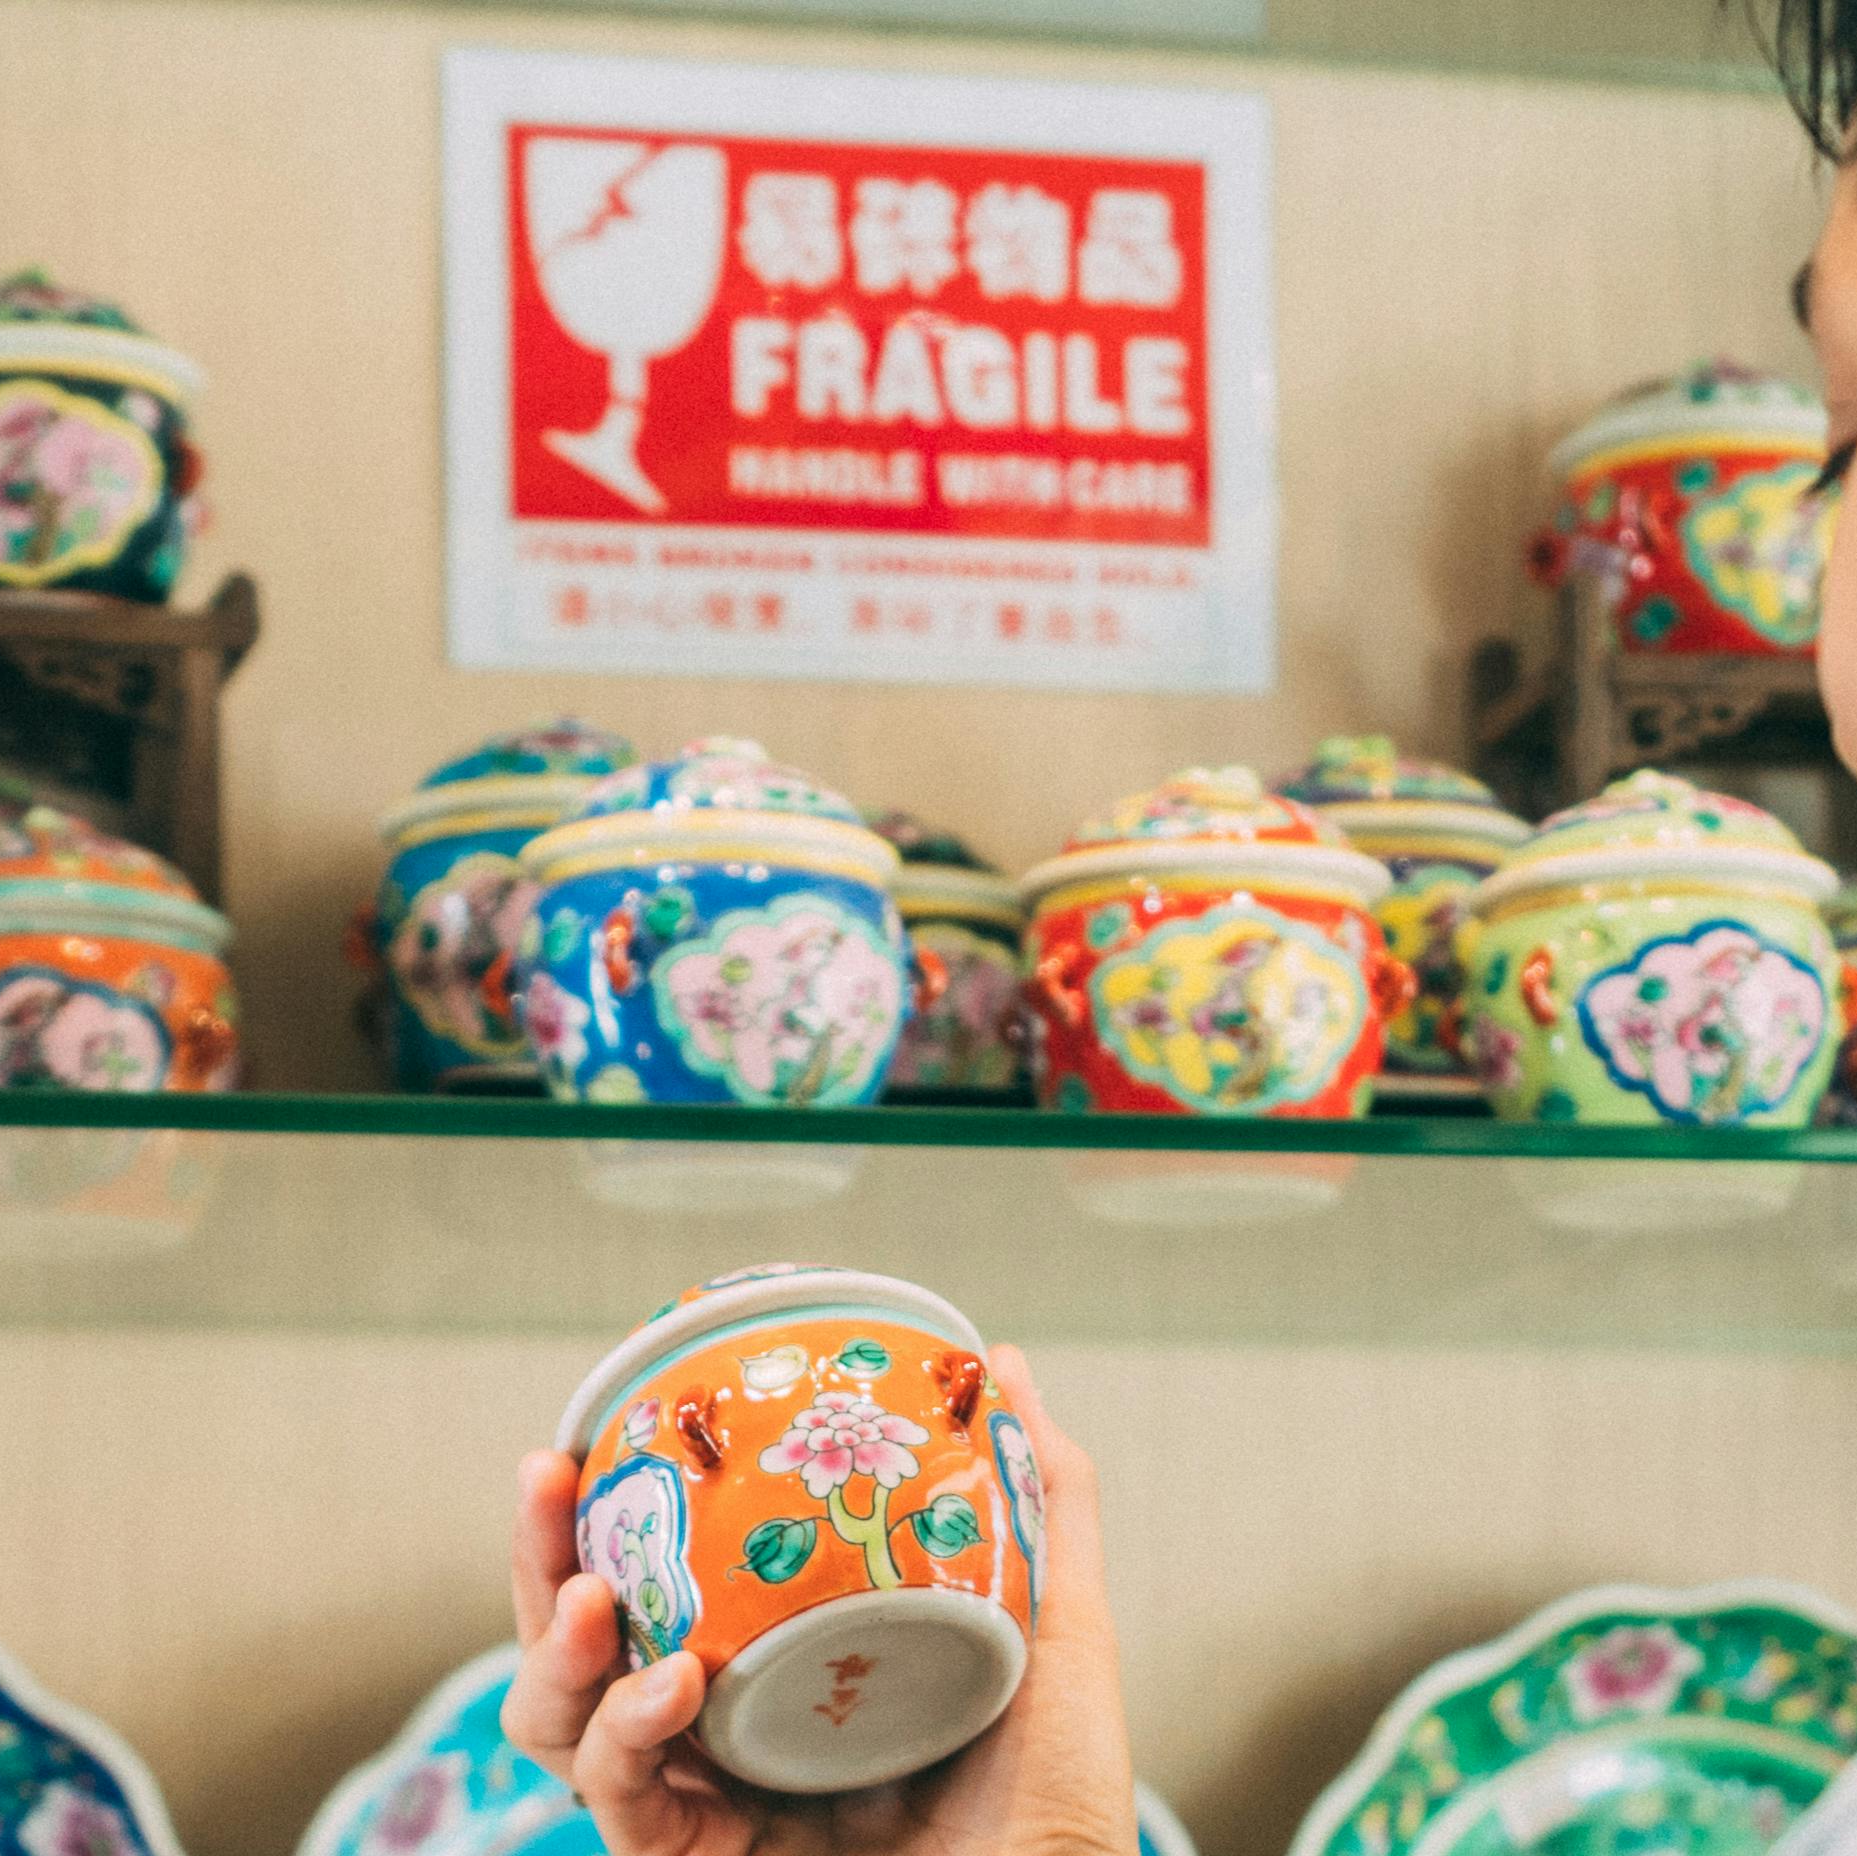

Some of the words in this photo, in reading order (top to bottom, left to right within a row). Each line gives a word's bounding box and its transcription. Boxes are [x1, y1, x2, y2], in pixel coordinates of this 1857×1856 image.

[730, 315, 1193, 438] FRAGILE
[728, 446, 925, 507] HANDLE
[937, 452, 1062, 510] WITH
[1066, 458, 1192, 517] CARE
